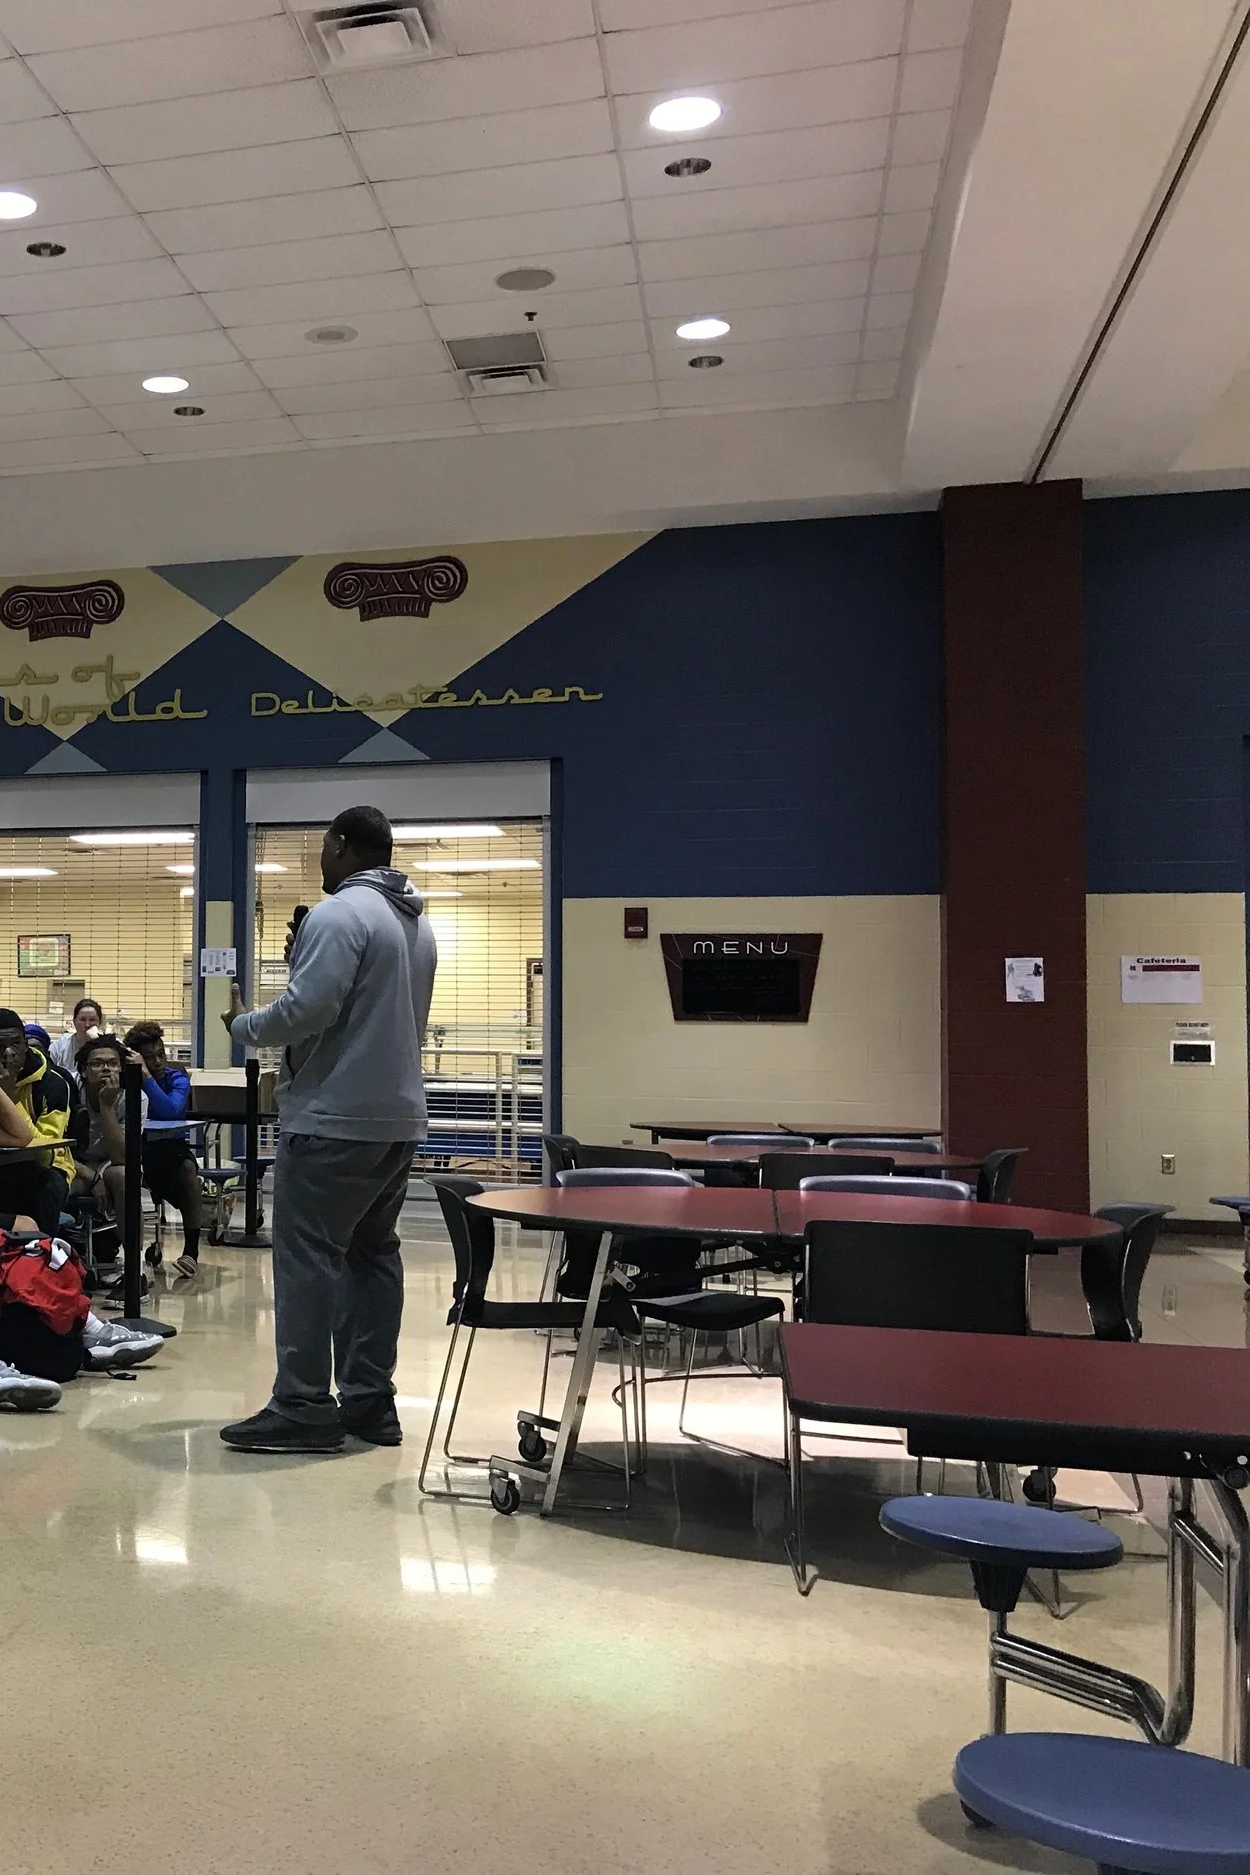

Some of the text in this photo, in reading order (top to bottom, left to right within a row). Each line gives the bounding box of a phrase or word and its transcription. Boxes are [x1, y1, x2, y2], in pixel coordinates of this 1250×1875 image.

[72, 654, 141, 700] of
[4, 688, 208, 727] World
[250, 684, 604, 717] Delicatessen
[692, 941, 789, 955] MENU
